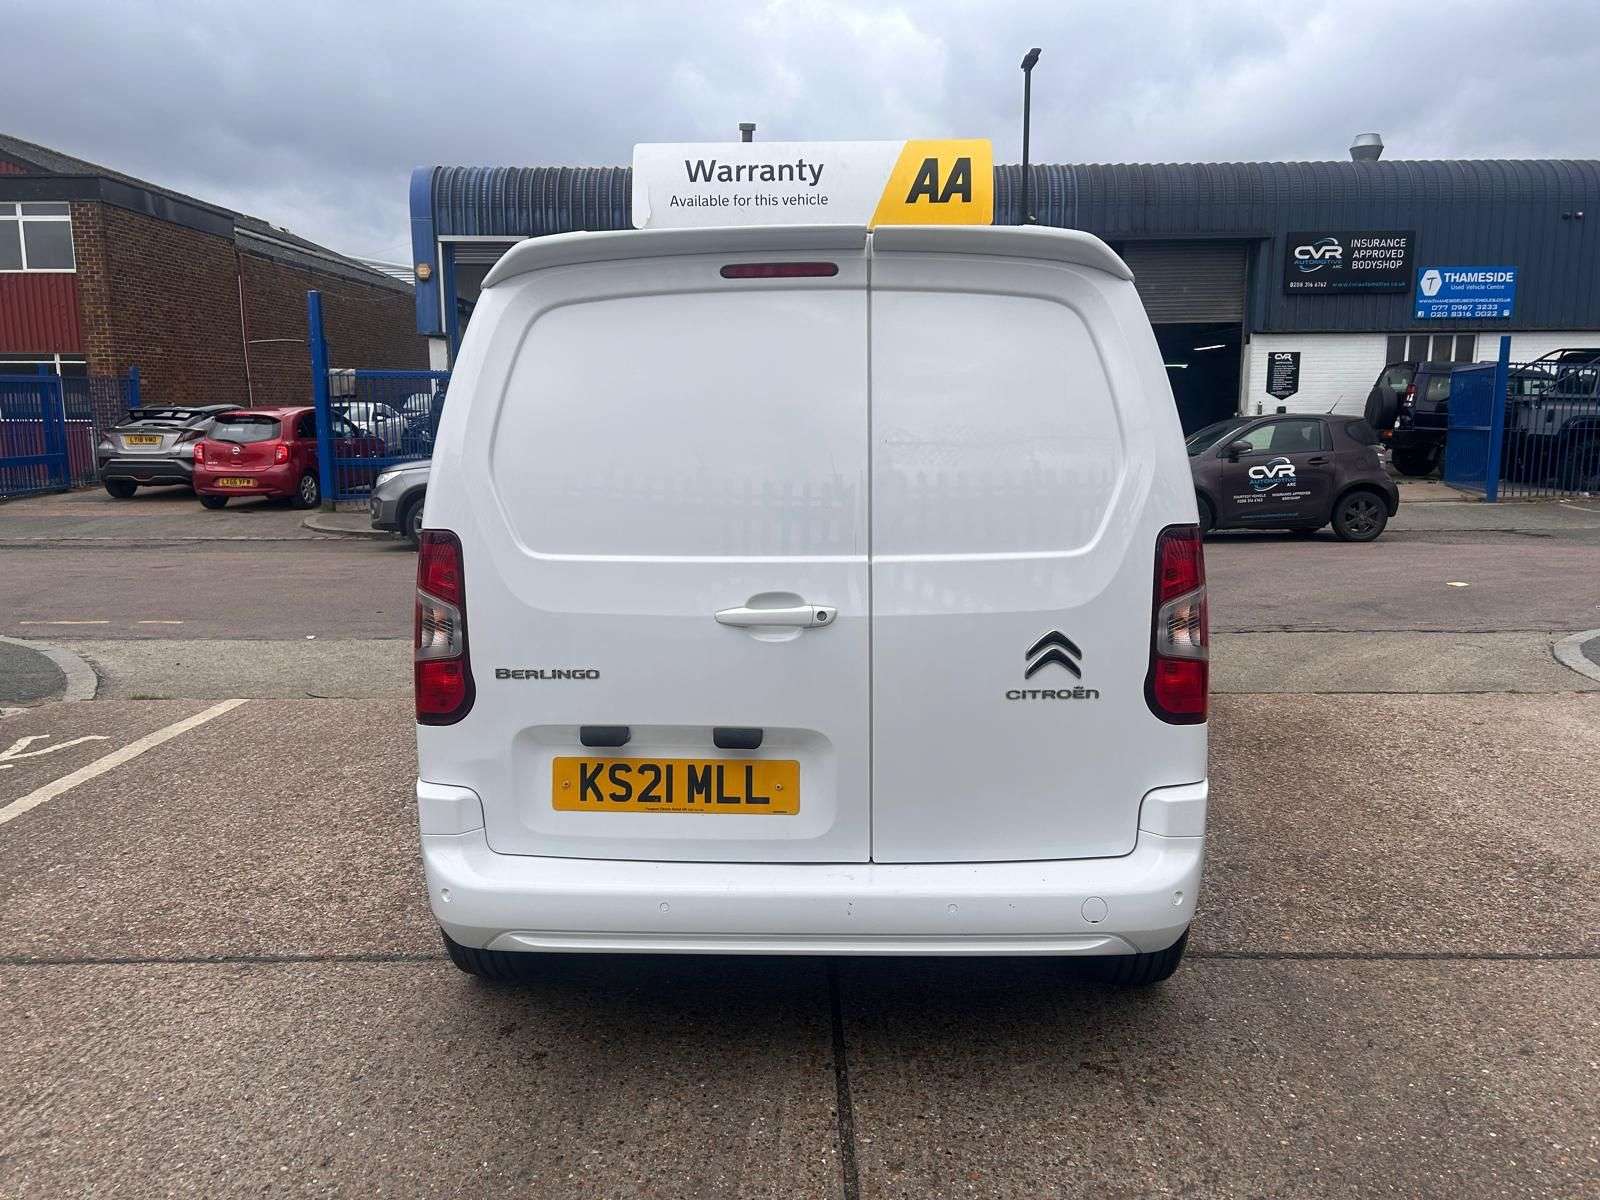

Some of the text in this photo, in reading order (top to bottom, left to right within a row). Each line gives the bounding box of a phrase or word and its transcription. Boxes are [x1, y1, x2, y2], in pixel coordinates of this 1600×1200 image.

[685, 159, 824, 186] Warranty
[905, 157, 972, 204] AA
[669, 193, 829, 207] Available for this vehicle
[1350, 238, 1407, 248] INSURANCE
[1294, 245, 1343, 260] CVR
[1352, 249, 1404, 259] APPROVED
[1351, 260, 1403, 270] BODYSHOP
[1444, 272, 1514, 282] THAMESIDE
[1248, 464, 1296, 479] CVR
[495, 668, 600, 680] BERLINGO
[1006, 686, 1099, 700] CITROËN
[578, 763, 770, 805] KS21 MLL
